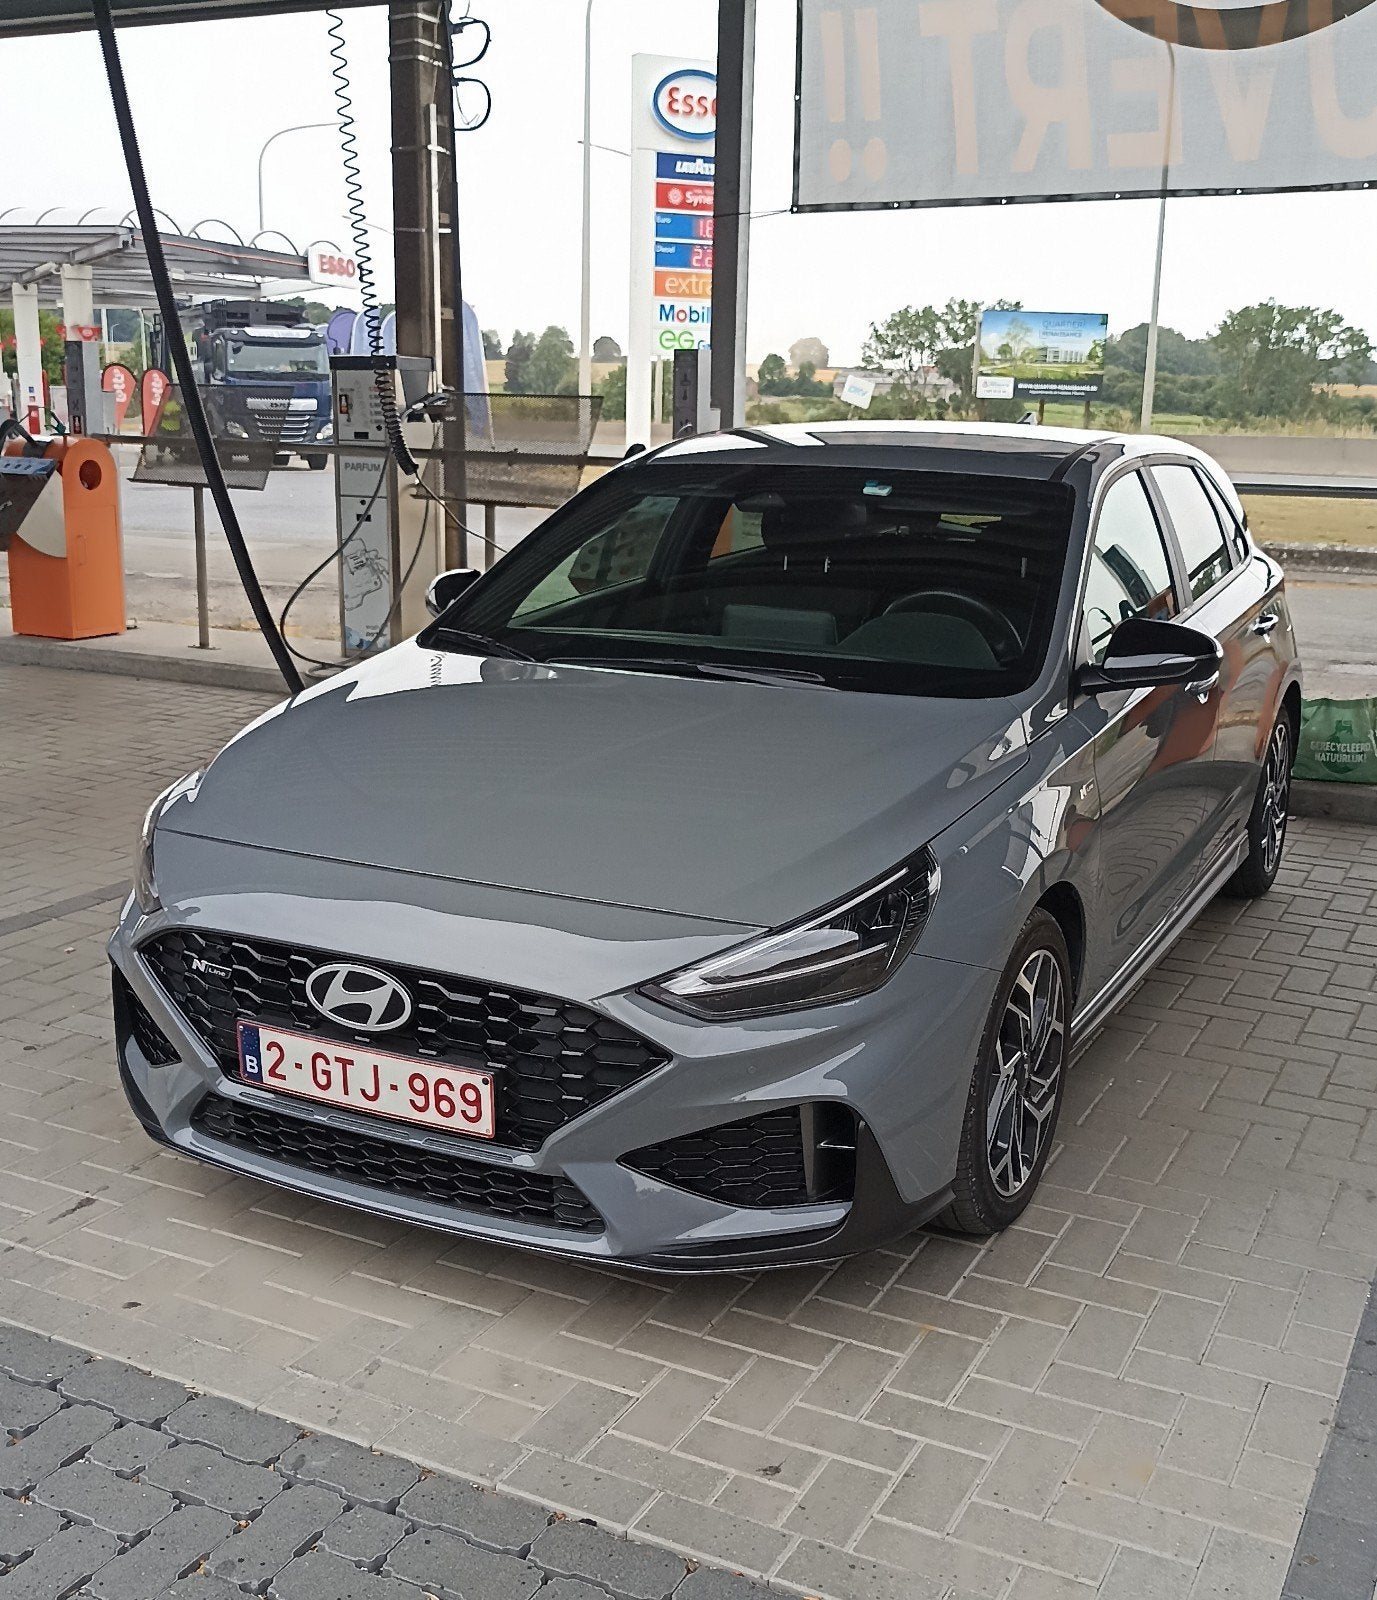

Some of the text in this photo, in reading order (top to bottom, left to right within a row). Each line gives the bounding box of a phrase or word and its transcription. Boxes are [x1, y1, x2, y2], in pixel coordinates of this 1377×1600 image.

[318, 253, 356, 278] ESSO
[344, 462, 381, 472] PARFUM
[192, 958, 207, 973] N
[245, 1054, 259, 1074] B
[266, 1041, 483, 1124] 2-GTJ-969
